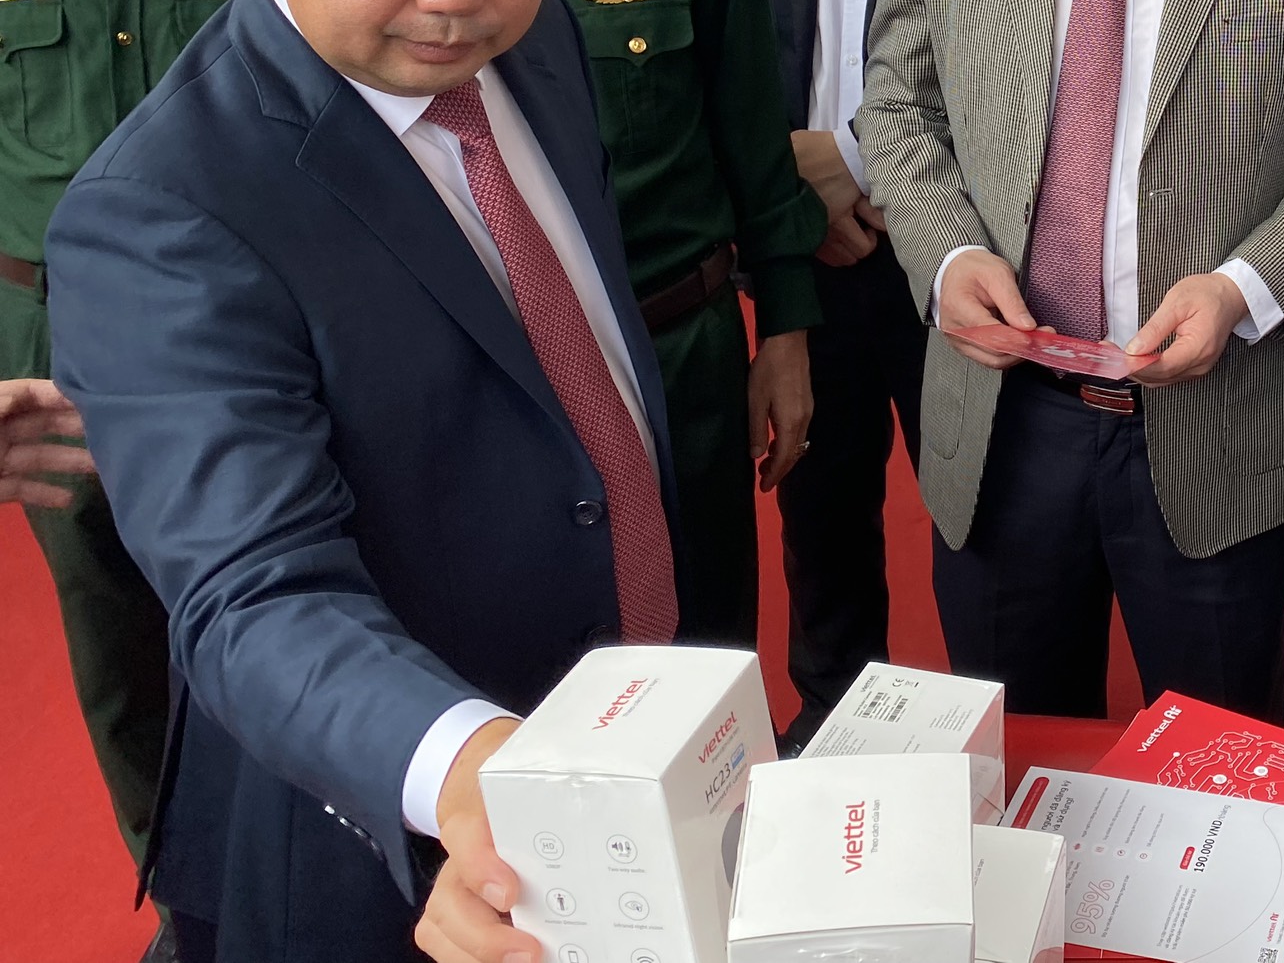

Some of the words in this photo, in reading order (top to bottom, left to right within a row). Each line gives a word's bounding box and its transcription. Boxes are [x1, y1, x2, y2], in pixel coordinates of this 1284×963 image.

[592, 678, 648, 730] viettel
[698, 711, 737, 764] viettel
[1137, 719, 1174, 752] viettel
[705, 763, 731, 804] HC23
[542, 842, 555, 850] HD
[842, 801, 865, 874] viettel
[870, 837, 879, 853] Theo
[1193, 838, 1215, 872] 190.000
[1070, 879, 1115, 935] 95%
